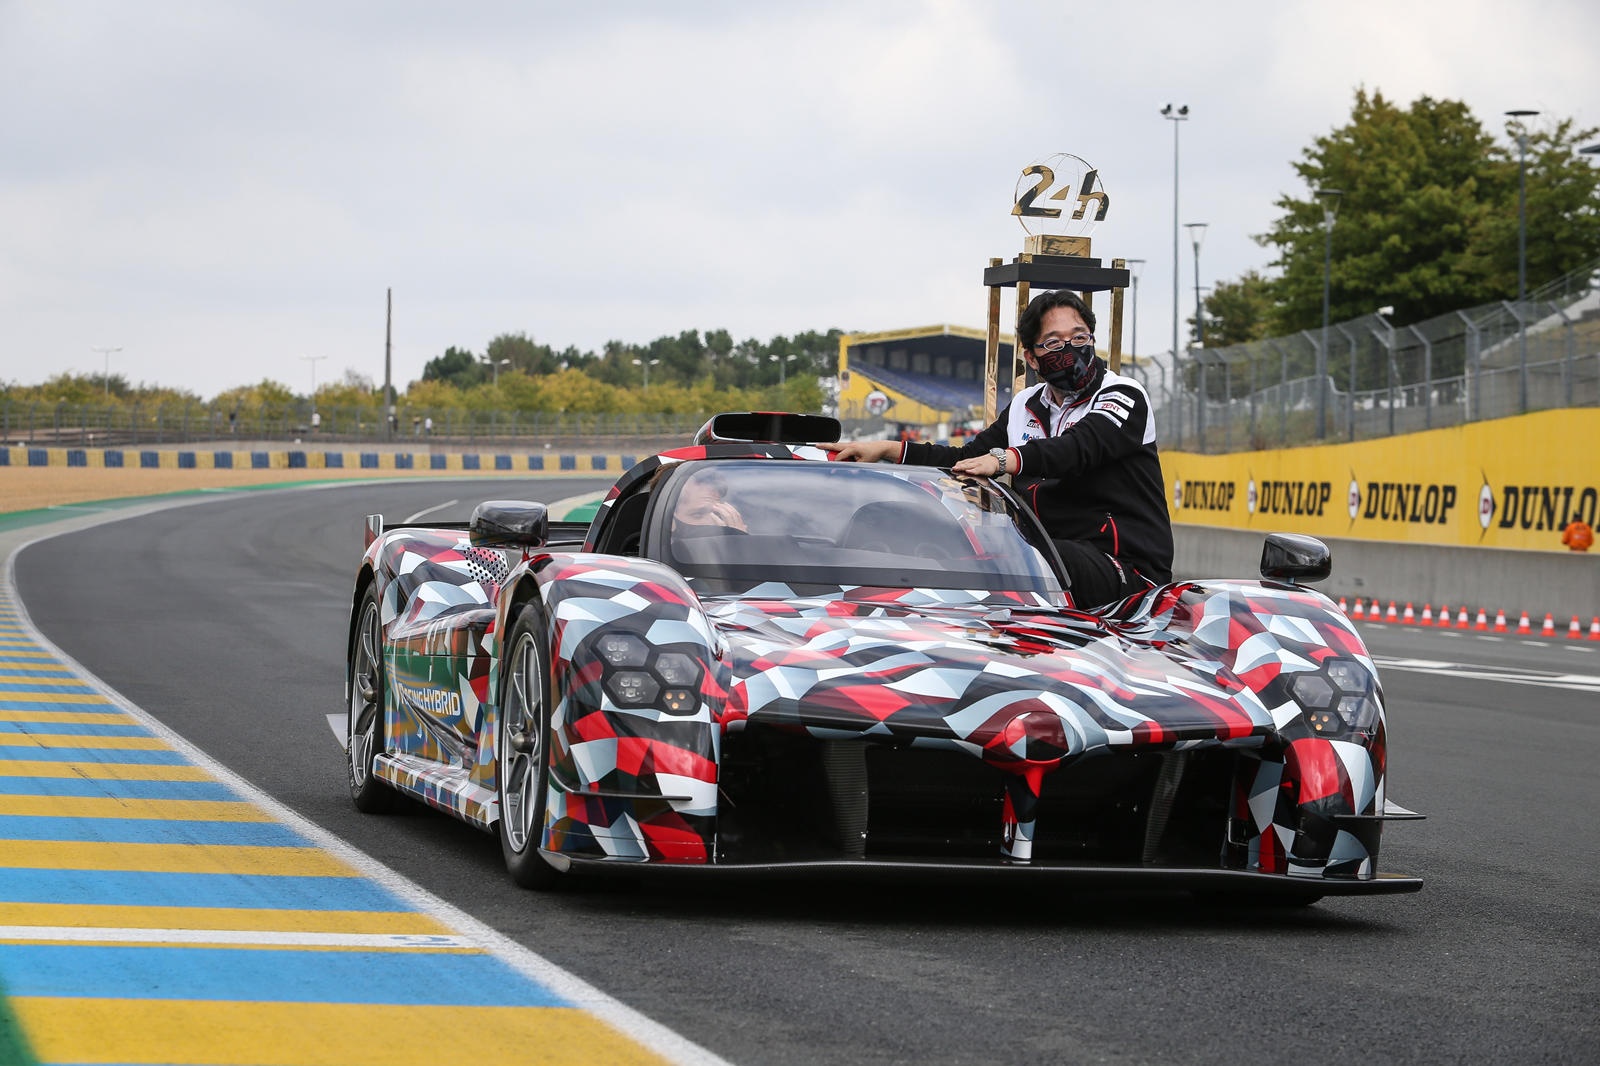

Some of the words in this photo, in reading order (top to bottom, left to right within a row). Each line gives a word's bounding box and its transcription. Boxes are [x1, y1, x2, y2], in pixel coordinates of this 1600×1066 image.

[1011, 165, 1109, 221] 24h
[1101, 403, 1121, 412] ZENT
[1183, 480, 1235, 511] DUNLOP
[1259, 481, 1331, 516] DUNLOP
[1364, 482, 1457, 524] DUNLOP
[1498, 486, 1600, 533] DUNLO
